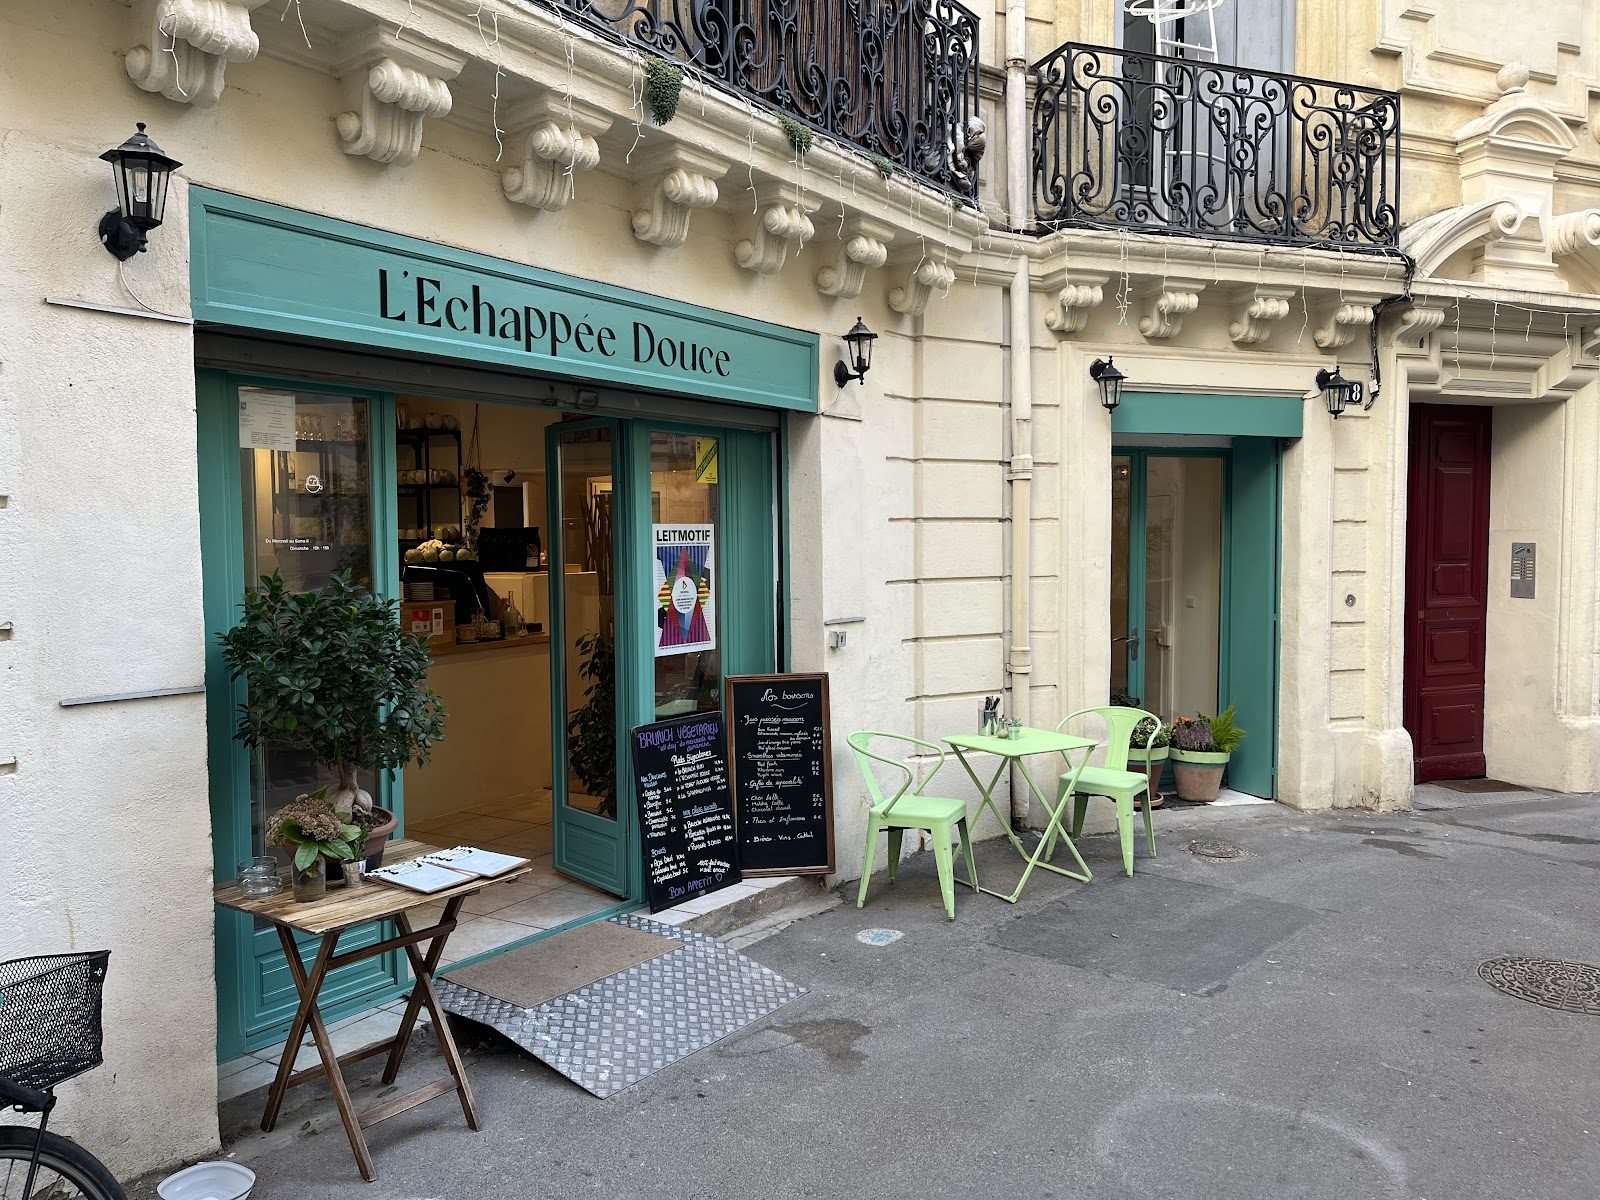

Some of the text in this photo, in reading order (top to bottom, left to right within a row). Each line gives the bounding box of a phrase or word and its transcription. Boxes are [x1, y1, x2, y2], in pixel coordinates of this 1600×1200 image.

[379, 269, 731, 377] L'Echappée Douce
[656, 530, 710, 542] LEITMOTIF
[760, 688, 814, 702] Nos boissons
[744, 714, 758, 726] Jus
[637, 727, 674, 748] BRUNCH
[671, 750, 712, 764] Plats Signatures
[668, 886, 685, 899] BON
